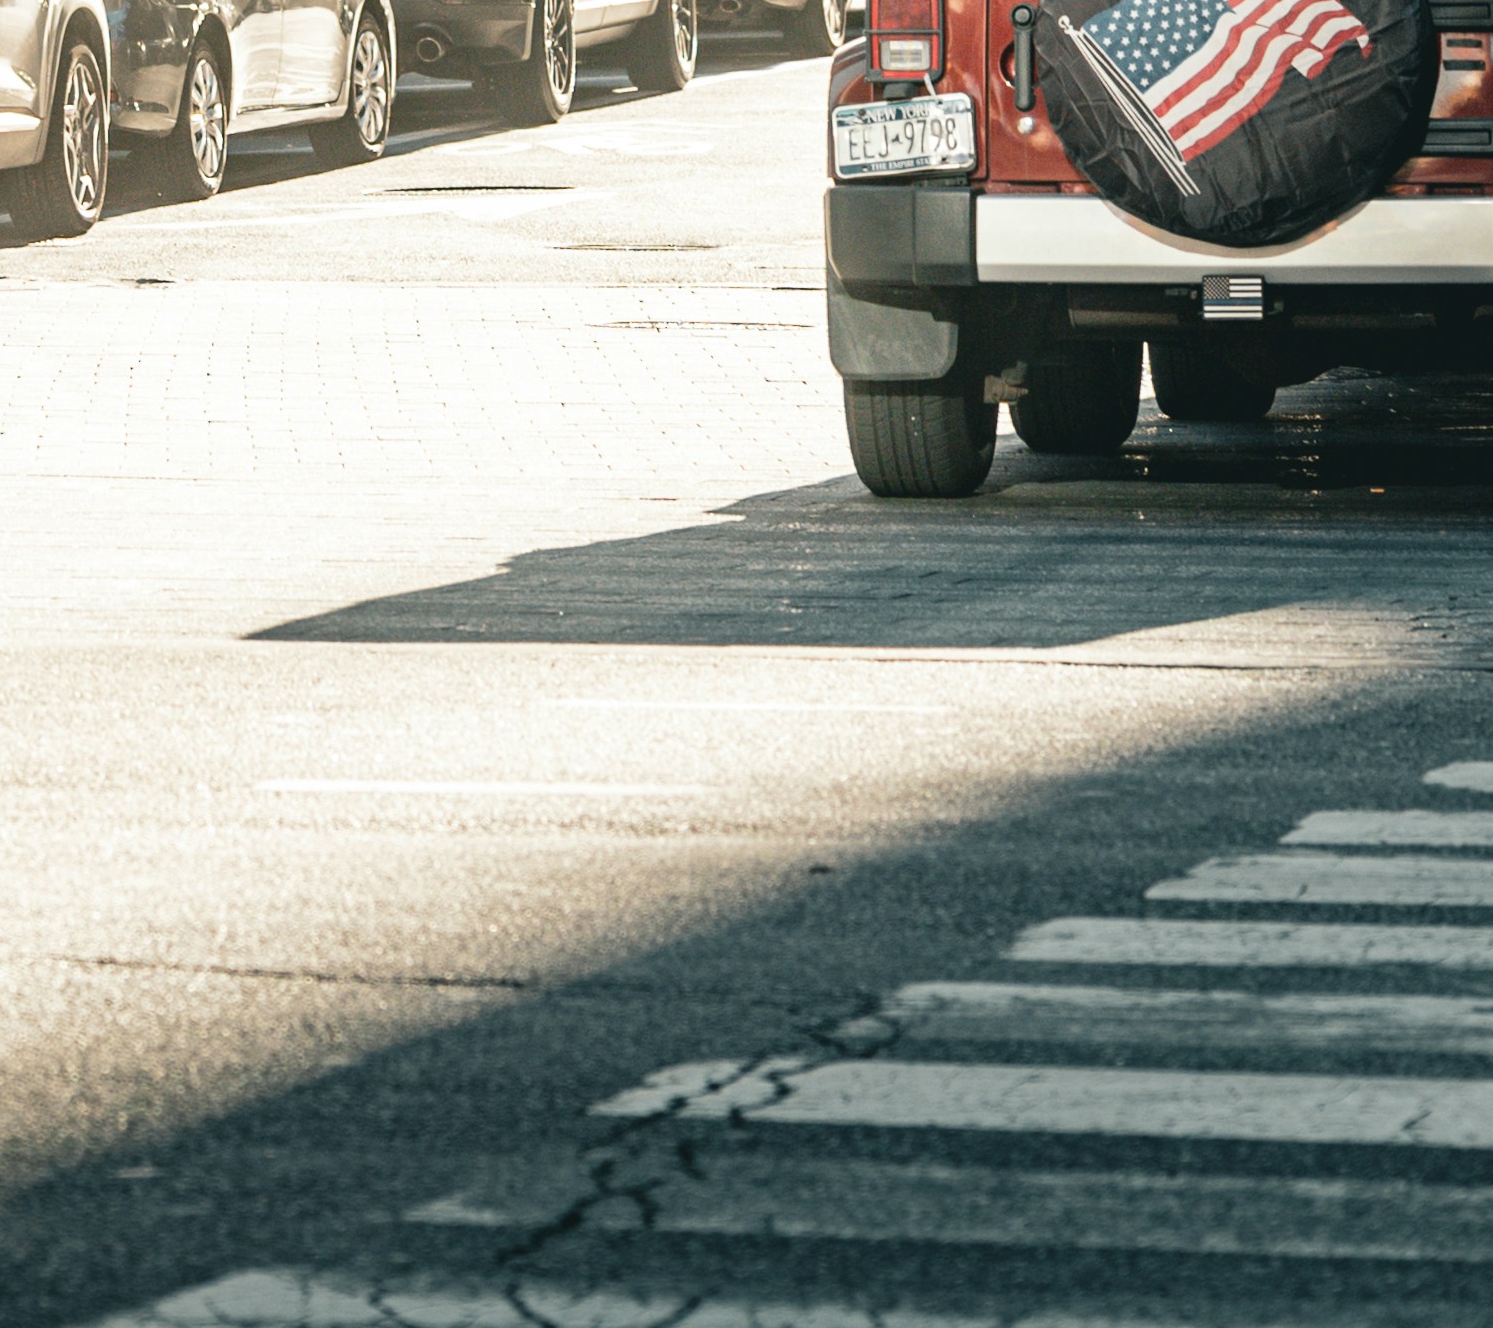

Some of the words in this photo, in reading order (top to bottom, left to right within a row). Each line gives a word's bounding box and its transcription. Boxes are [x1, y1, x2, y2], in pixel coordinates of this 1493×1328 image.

[866, 106, 898, 125] NEW
[849, 124, 891, 161] EEJ
[903, 116, 959, 155] 9798
[870, 161, 886, 172] THE
[887, 159, 914, 171] EMPIRE
[915, 156, 931, 168] STA
